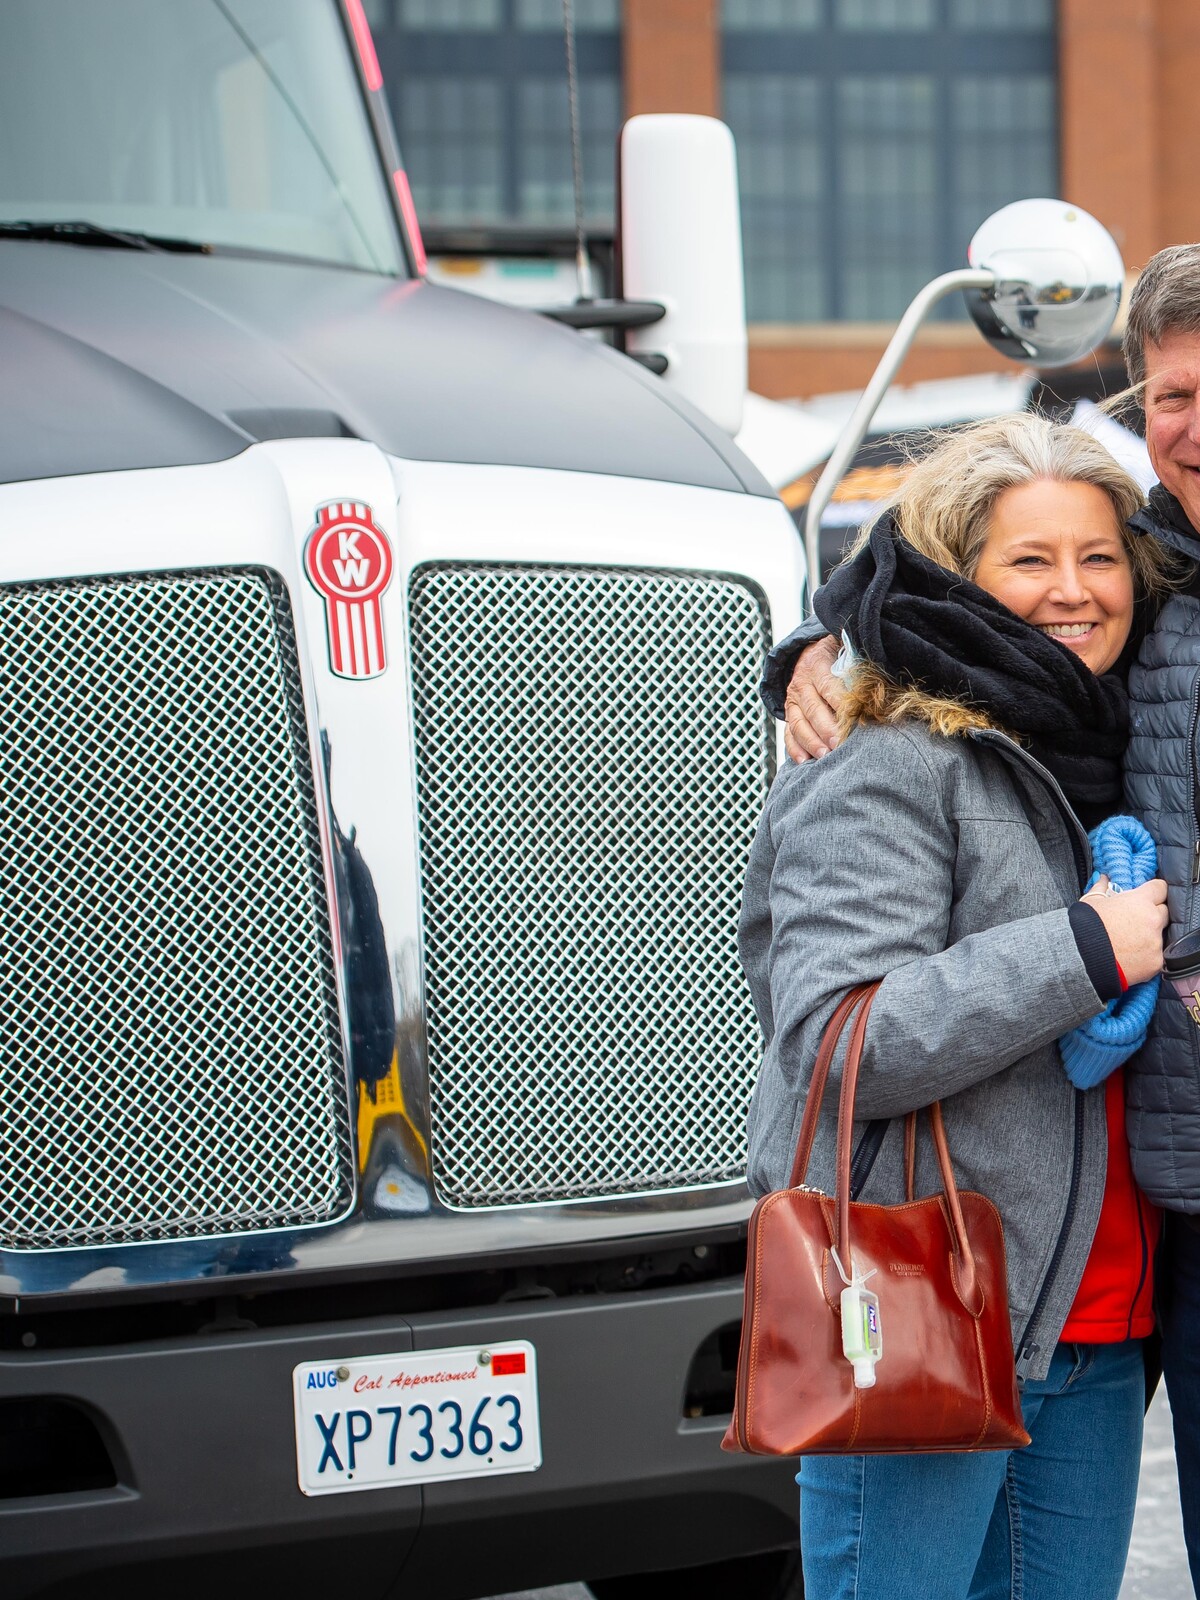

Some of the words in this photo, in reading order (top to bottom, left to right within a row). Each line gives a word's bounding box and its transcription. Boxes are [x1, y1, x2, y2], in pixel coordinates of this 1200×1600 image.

[306, 1370, 338, 1390] AUG
[353, 1374, 383, 1393] Cal
[387, 1366, 478, 1391] Apportioned
[314, 1394, 524, 1474] XP73363
